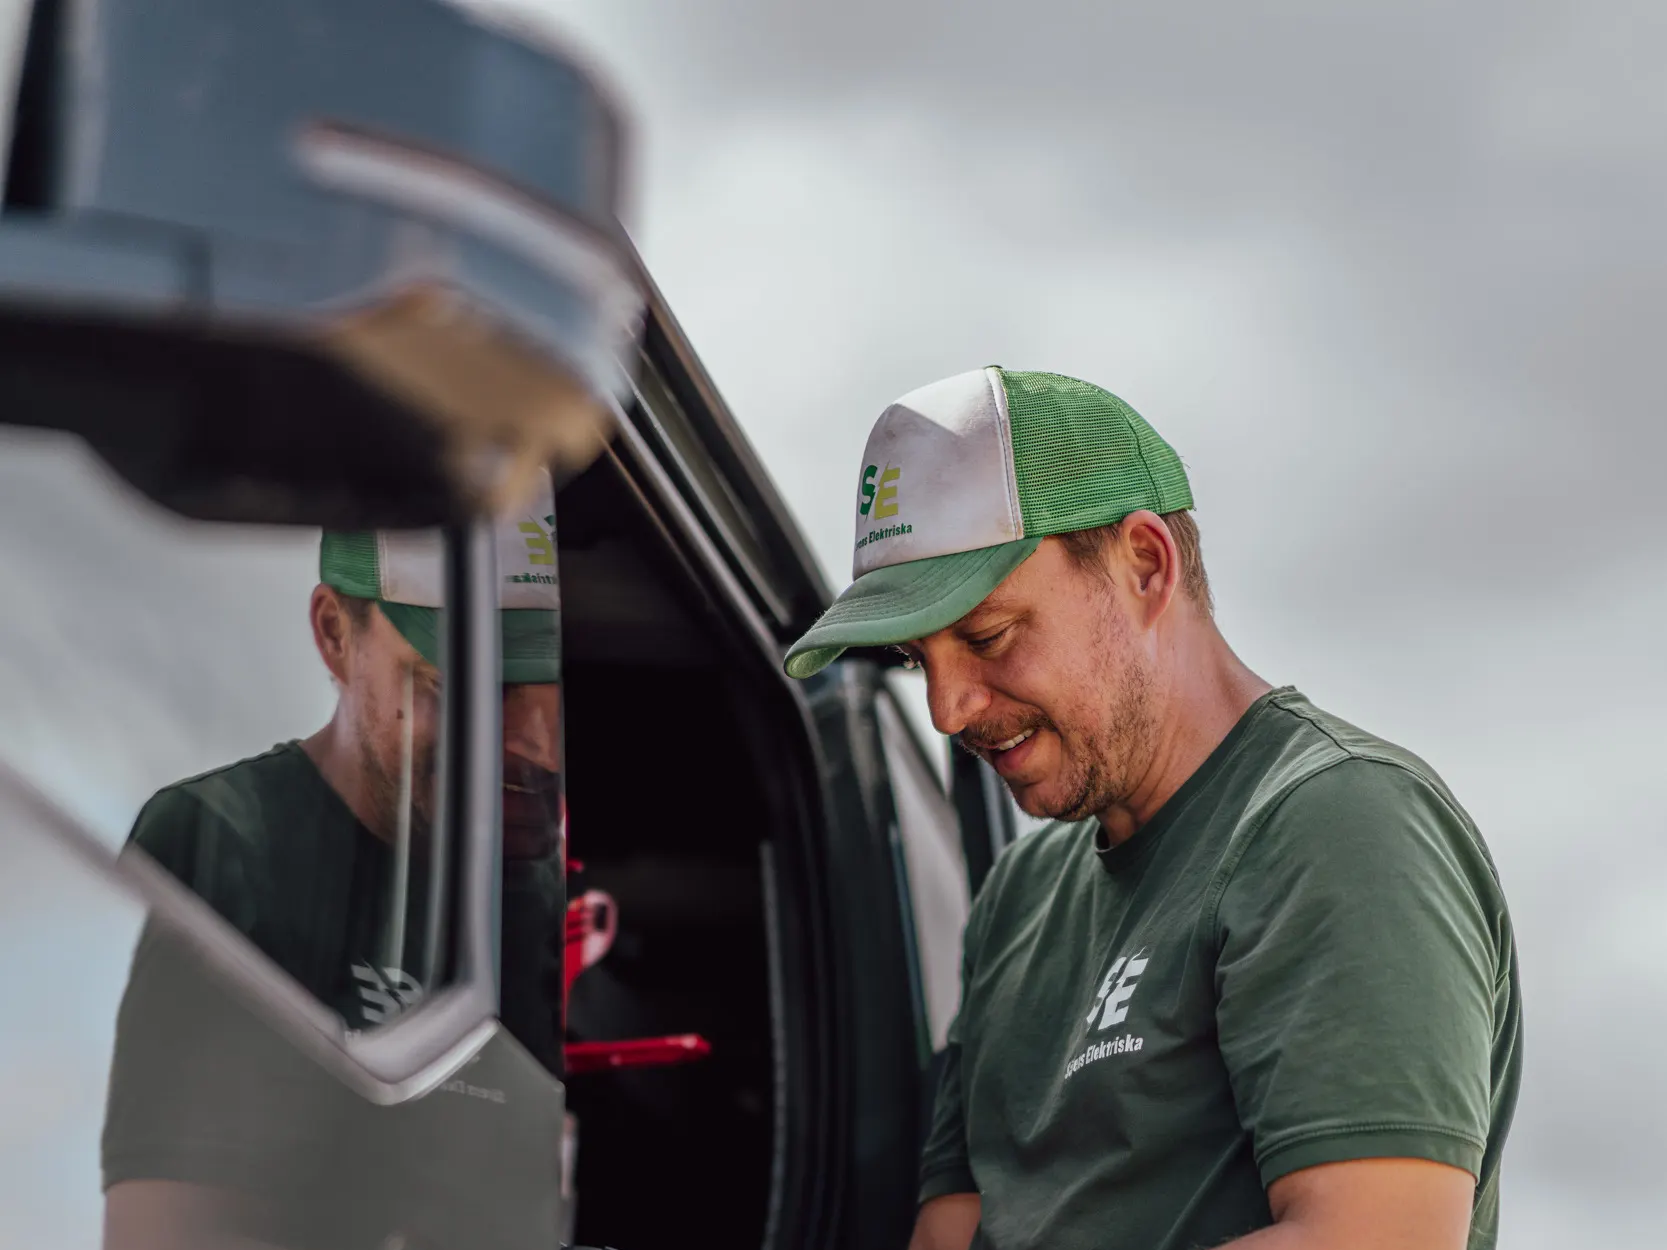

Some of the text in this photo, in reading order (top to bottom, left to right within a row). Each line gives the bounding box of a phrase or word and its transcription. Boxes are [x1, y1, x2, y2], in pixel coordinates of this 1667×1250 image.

[860, 462, 901, 522] SE
[869, 522, 913, 544] Elektriska
[1085, 1033, 1144, 1065] Elektriska
